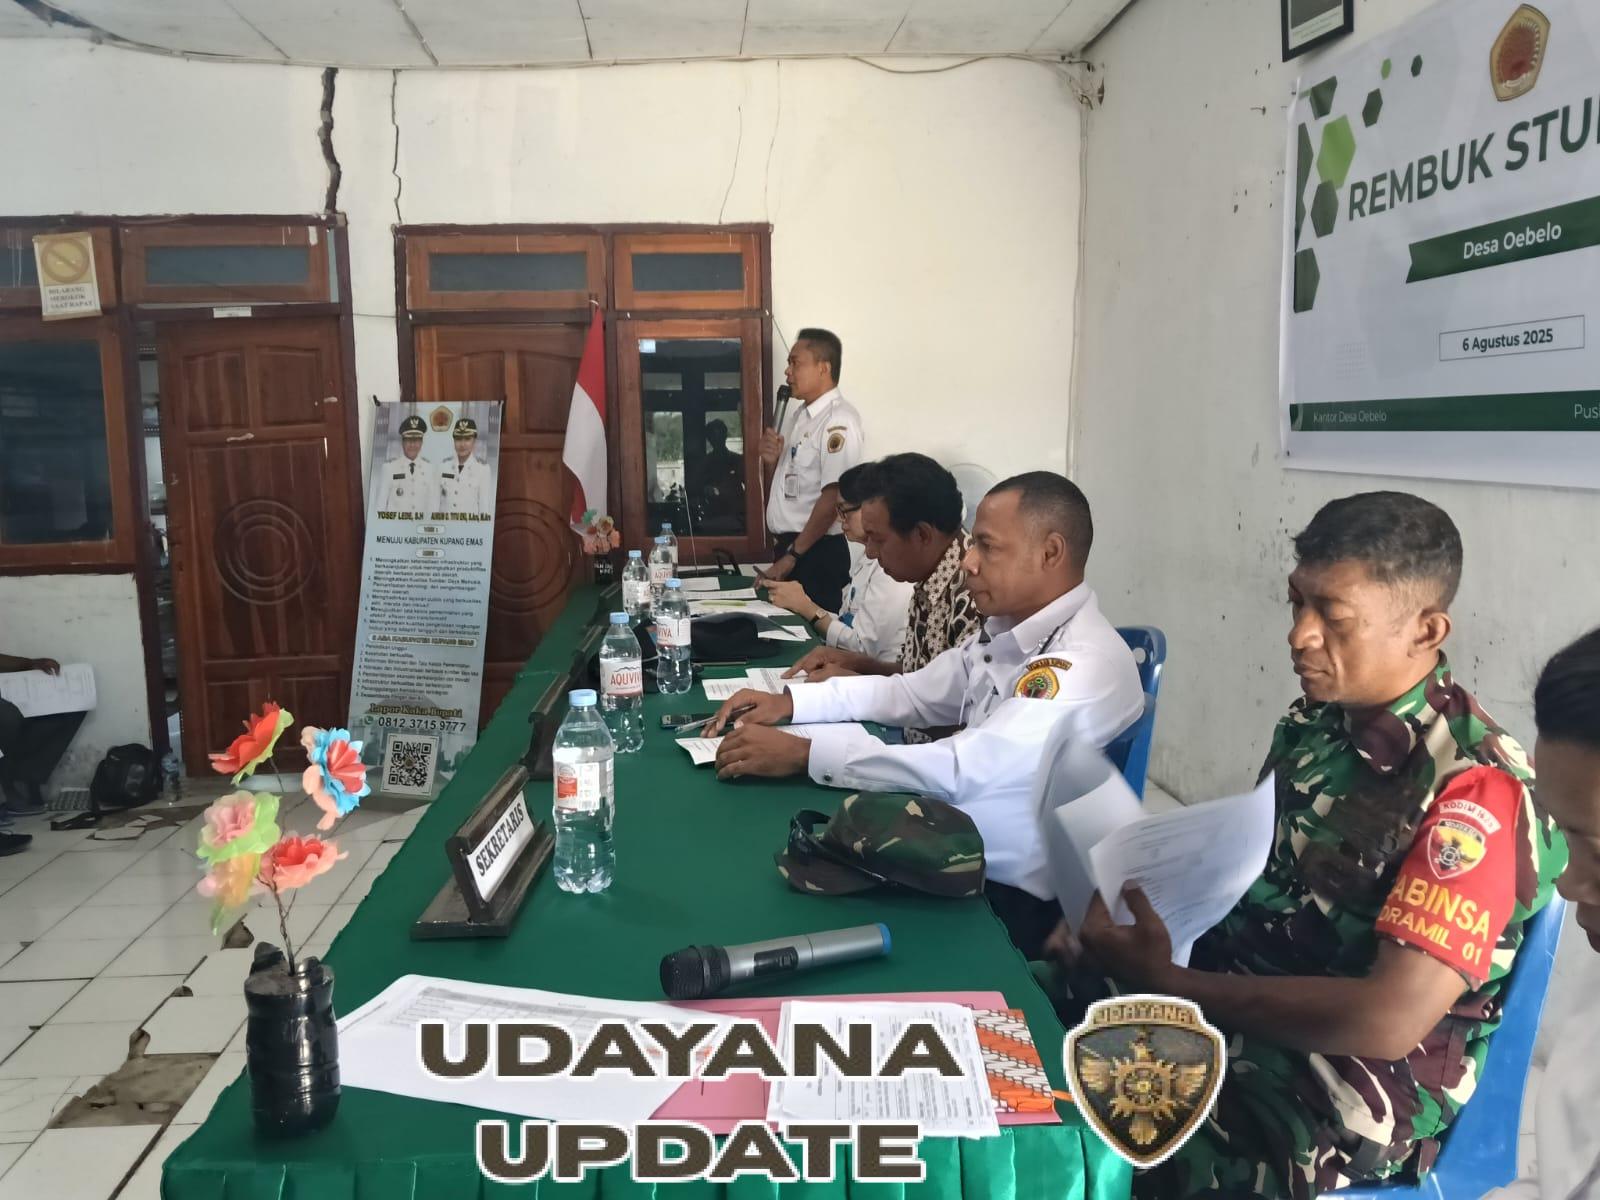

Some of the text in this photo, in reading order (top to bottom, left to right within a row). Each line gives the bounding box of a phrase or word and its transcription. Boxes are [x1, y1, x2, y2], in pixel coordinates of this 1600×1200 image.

[1349, 92, 1600, 221] REMBUK STU
[1463, 222, 1562, 260] Desa Oebelo
[1462, 328, 1553, 353] 6 Agustus 2025
[1313, 410, 1387, 423] Kantor Desa Oebelo
[1574, 401, 1600, 419] Pus
[376, 535, 483, 546] MENUJU KABUPATEN KUPANG EMAS
[378, 717, 466, 732] 0812 3715 9777
[475, 802, 525, 877] SEKRETARIS
[1389, 874, 1491, 942] ABINSA
[1462, 942, 1482, 966] 01
